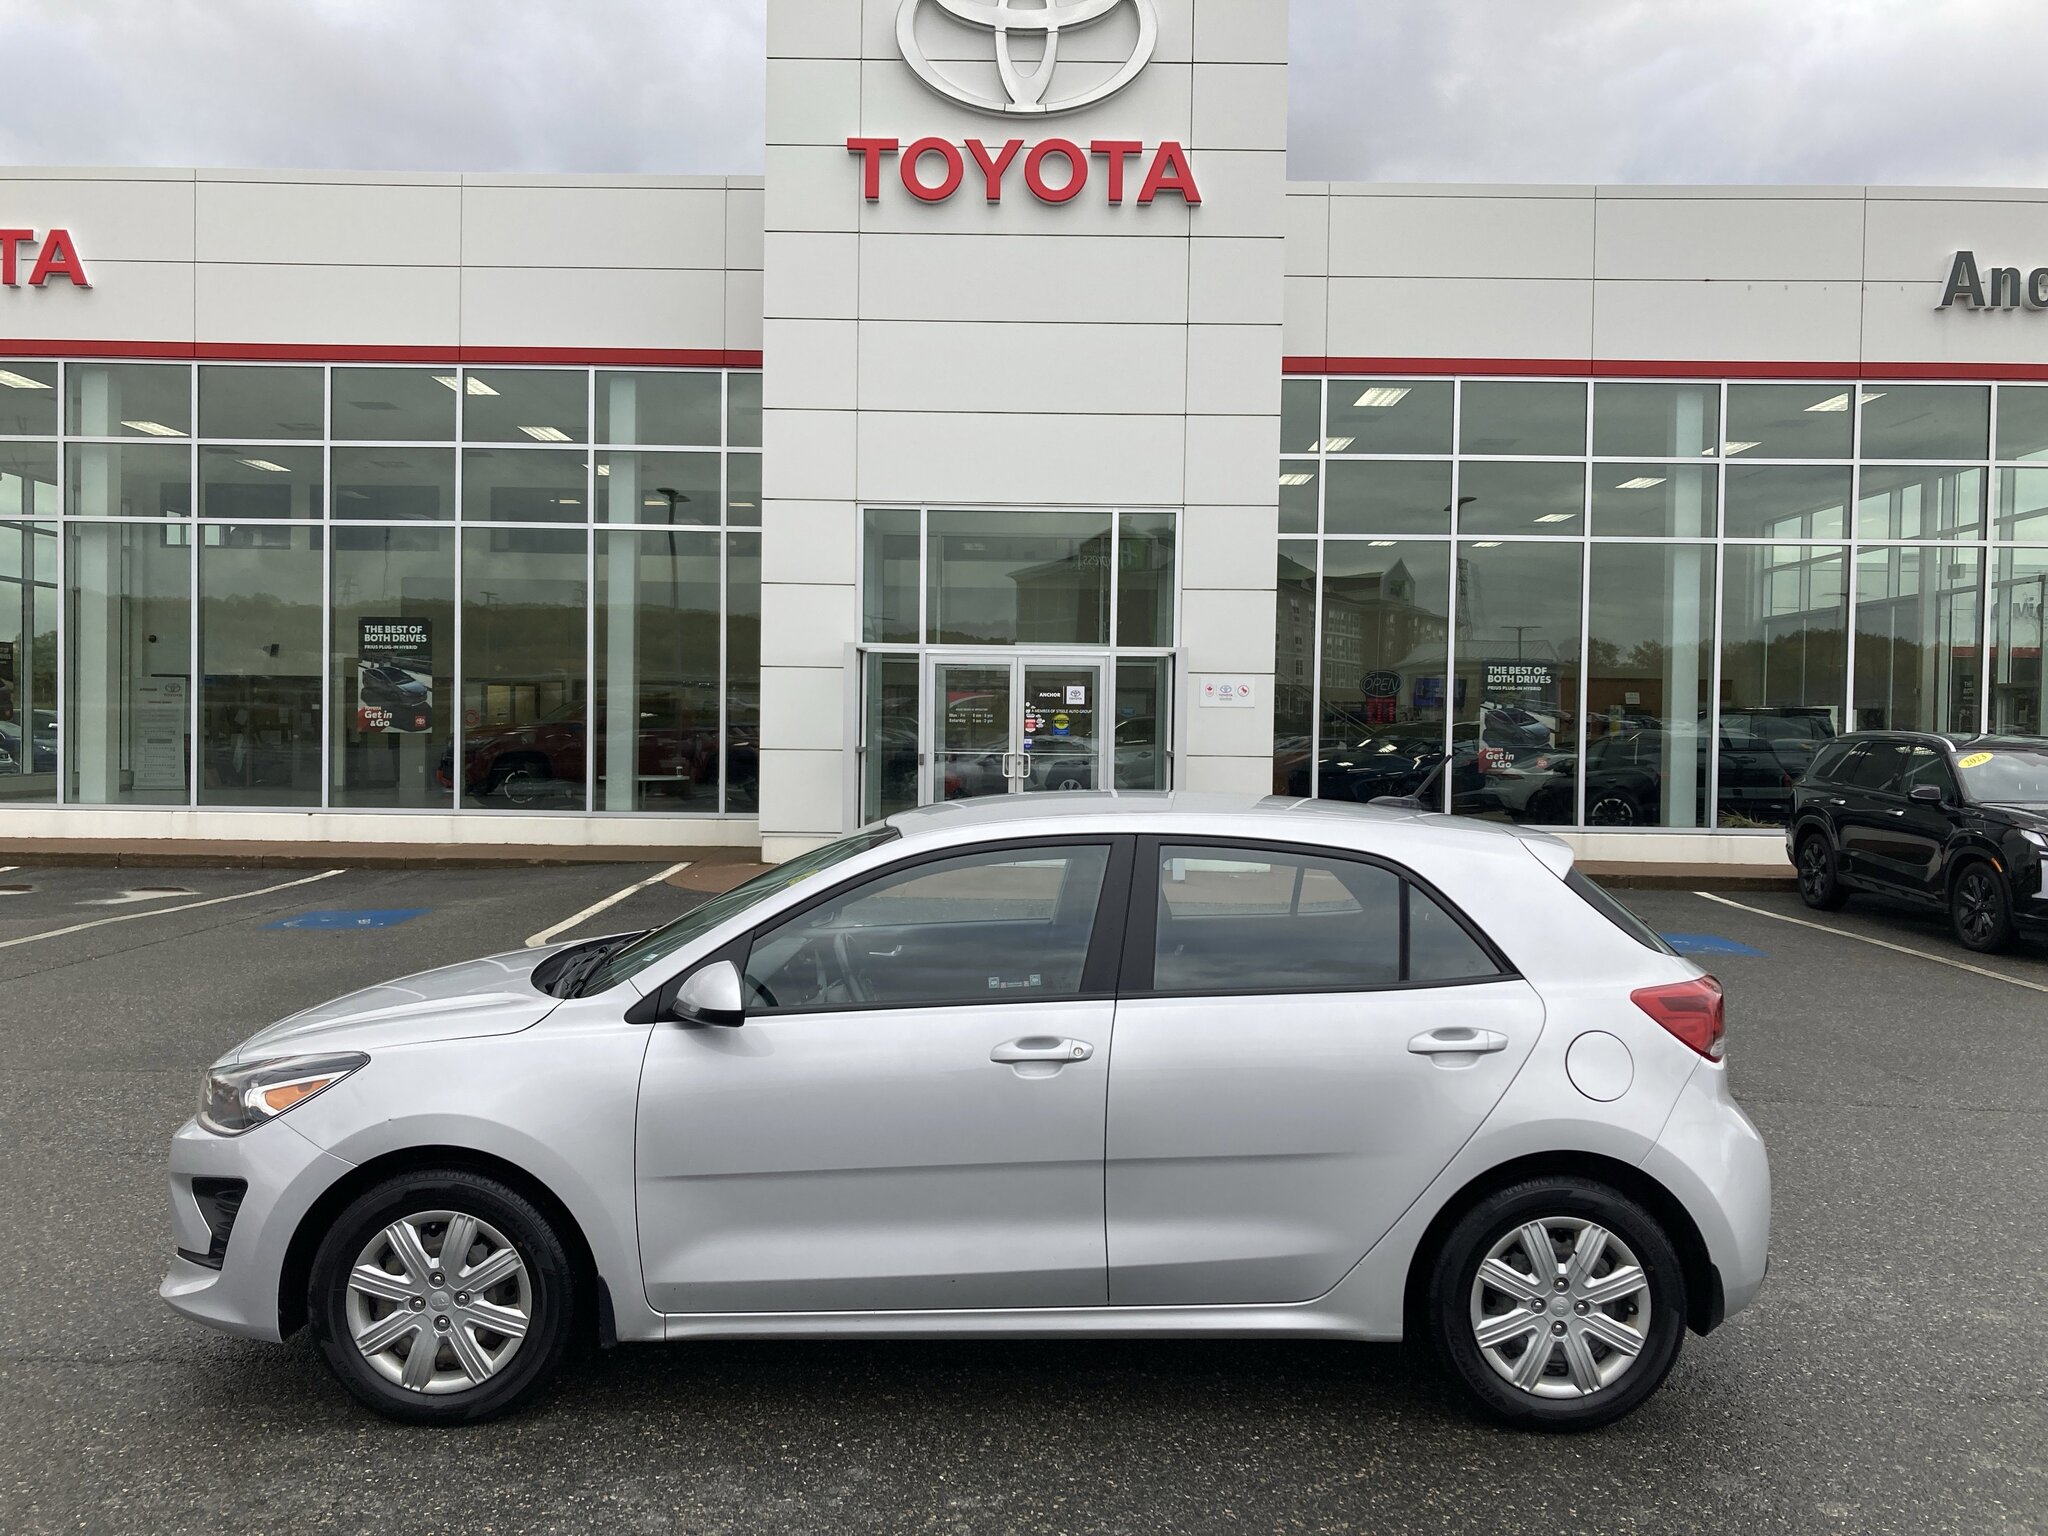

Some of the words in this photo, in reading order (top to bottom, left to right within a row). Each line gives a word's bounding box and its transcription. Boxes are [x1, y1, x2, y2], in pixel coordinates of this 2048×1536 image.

[847, 137, 1203, 205] TOYOTA
[364, 625, 383, 633] THE
[385, 625, 408, 633] BEST
[409, 626, 423, 634] OF
[364, 634, 390, 642] BOTH
[392, 634, 427, 642] DRIVES
[1488, 666, 1507, 674] THE
[1508, 666, 1533, 675] BEST
[1533, 667, 1547, 675] OF
[1363, 677, 1400, 691] OPEN
[1487, 675, 1515, 683] BOTH
[1516, 675, 1552, 684] DRIVES
[364, 711, 382, 719] Get
[383, 710, 393, 719] in
[1485, 752, 1504, 760] Get
[1504, 751, 1515, 760] in
[1963, 753, 1987, 766] 2023
